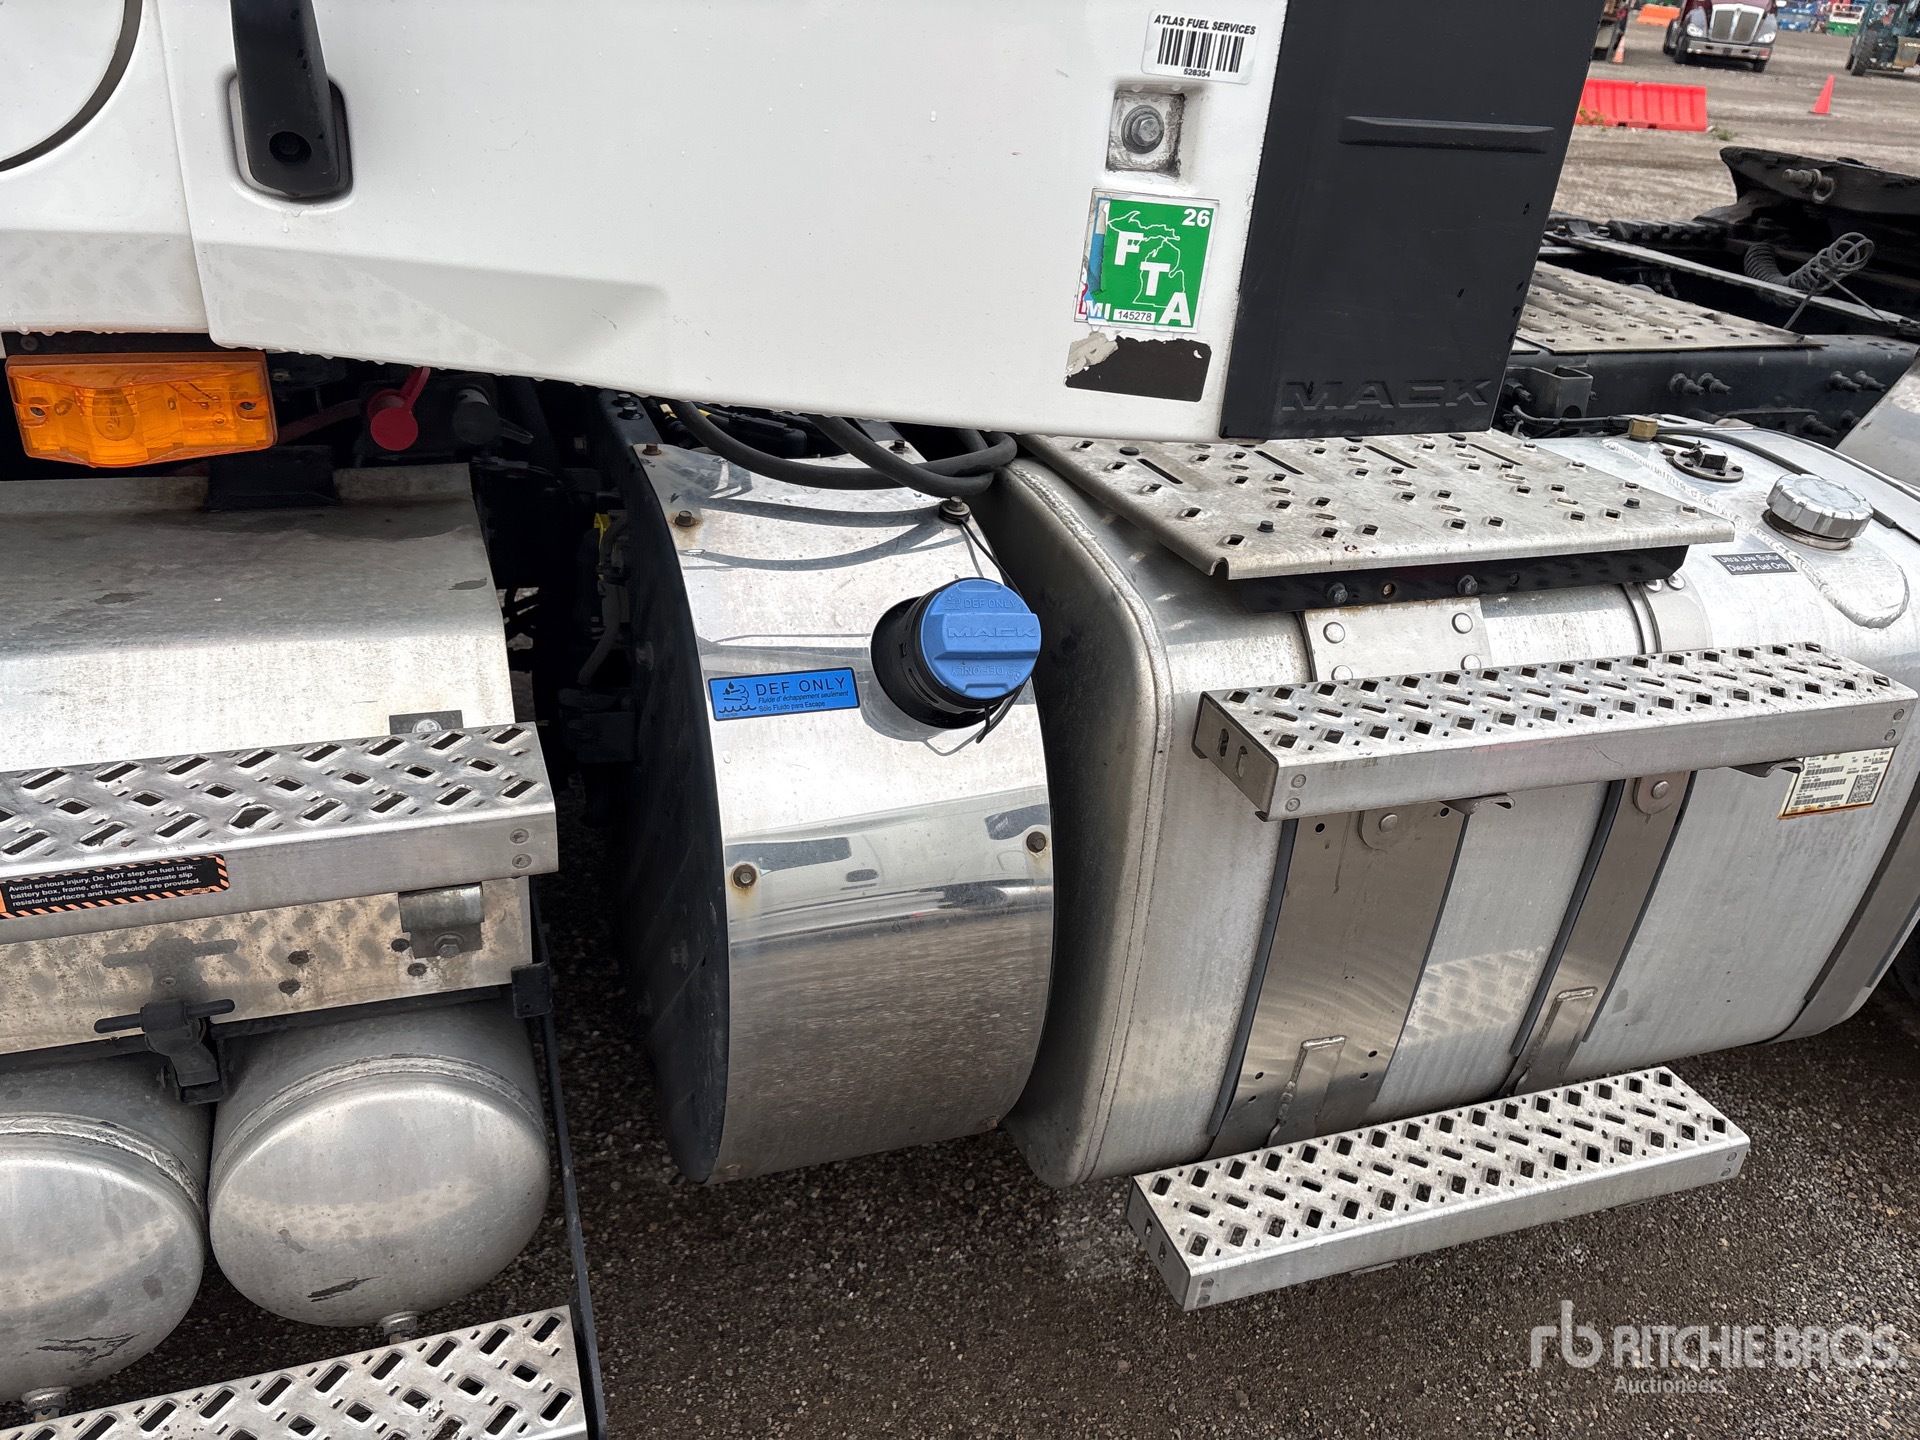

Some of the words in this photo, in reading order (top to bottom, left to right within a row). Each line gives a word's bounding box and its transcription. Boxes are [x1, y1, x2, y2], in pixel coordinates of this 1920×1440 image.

[1154, 14, 1185, 27] ATLAS
[1186, 18, 1210, 30] FUEL
[1212, 21, 1256, 35] SERVICES
[1183, 68, 1211, 78] 528354
[1181, 208, 1210, 228] 26
[1086, 299, 1112, 320] MI
[1117, 310, 1152, 322] 145278
[1281, 379, 1492, 411] MACK
[1727, 564, 1753, 572] Diesel
[1771, 562, 1791, 571] Only
[963, 598, 986, 609] DEF
[989, 598, 1017, 608] ONLY
[947, 627, 1038, 638] MACK
[755, 681, 791, 696] DEF
[799, 676, 845, 692] ONLY
[758, 696, 776, 704] Fluide
[820, 690, 849, 698] seulement
[773, 703, 790, 711] Fluido
[8, 884, 33, 892] Avoid
[34, 880, 65, 889] serious
[106, 872, 125, 880] NOT
[127, 870, 145, 878] step
[10, 891, 40, 900] battery
[110, 879, 137, 887] unless
[139, 874, 177, 884] adequate
[178, 871, 193, 879] slip
[12, 897, 49, 907] resistant
[50, 894, 86, 904] surfaces
[104, 886, 148, 895] handholds
[164, 878, 201, 889] provided.
